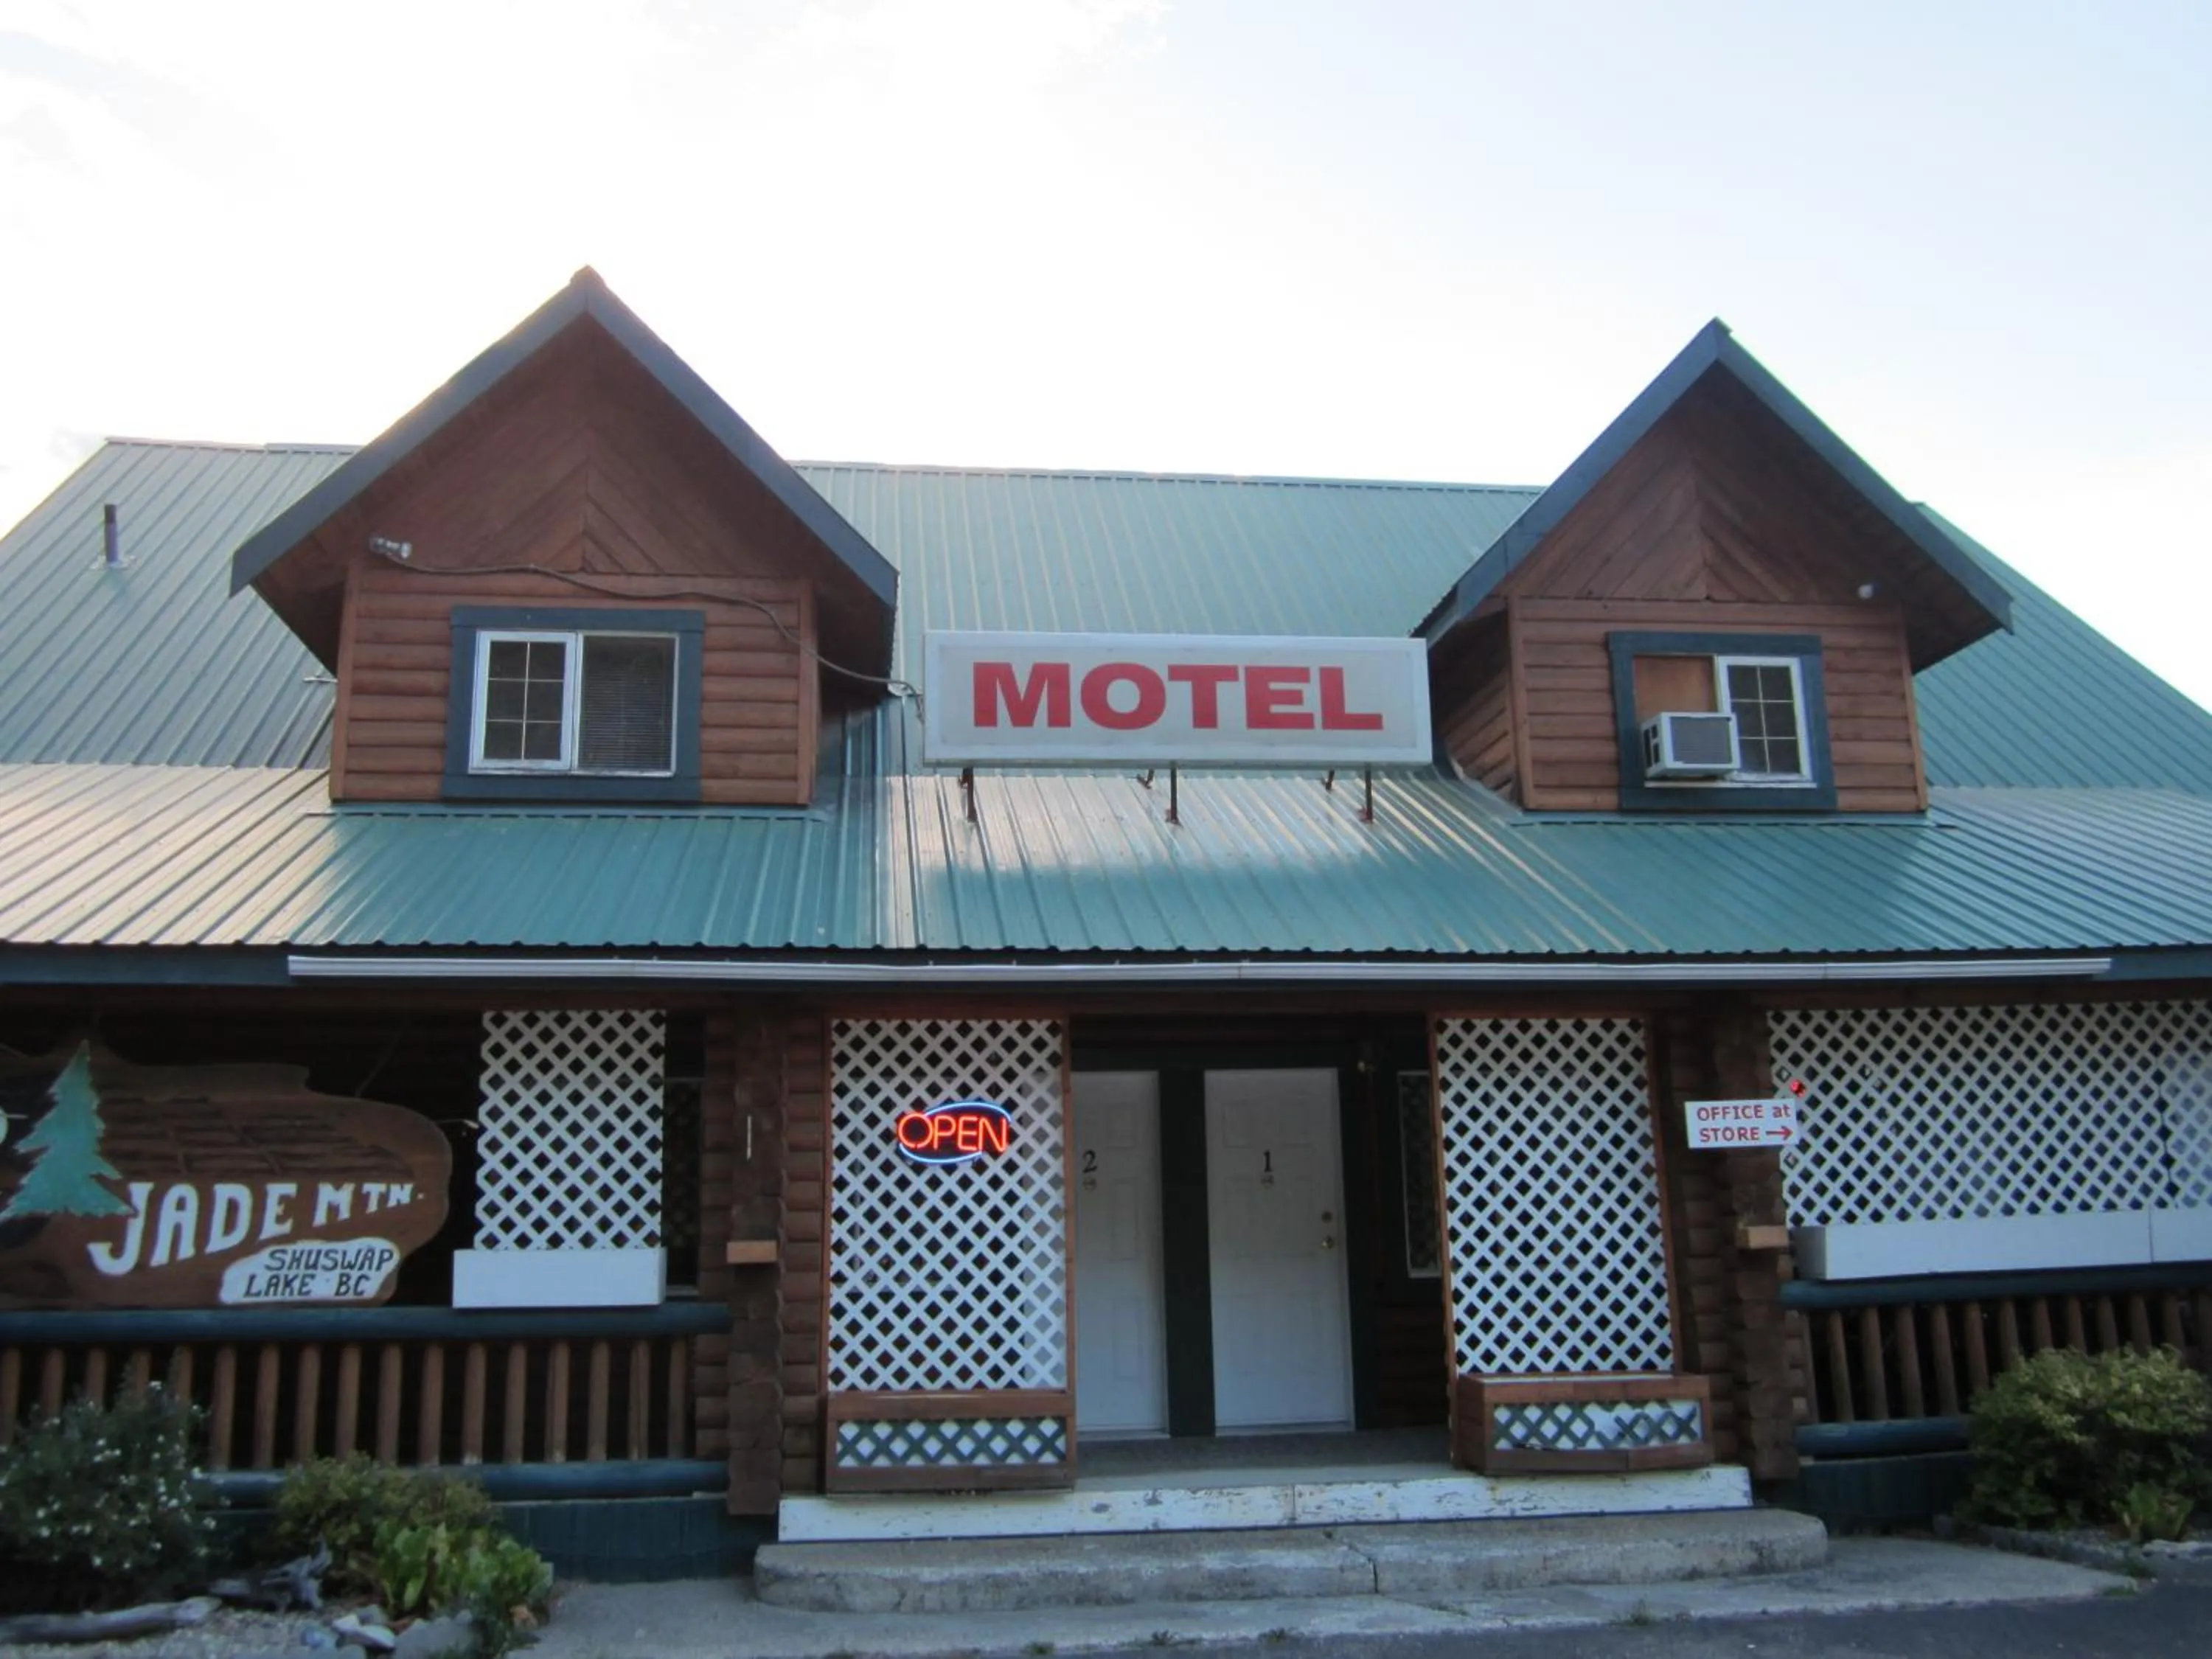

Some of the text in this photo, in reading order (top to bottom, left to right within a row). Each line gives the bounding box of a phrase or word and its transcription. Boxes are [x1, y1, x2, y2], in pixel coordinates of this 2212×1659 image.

[973, 661, 1384, 731] MOTEL
[1697, 1104, 1791, 1121] OFFICE at
[897, 1112, 1009, 1154] OPEN
[1700, 1126, 1761, 1143] STORE
[1082, 1150, 1098, 1174] 2
[1262, 1150, 1273, 1172] 1
[87, 1182, 297, 1276] JADE
[263, 1248, 395, 1272] SHUSWAP
[243, 1273, 371, 1298] LAKE BC
